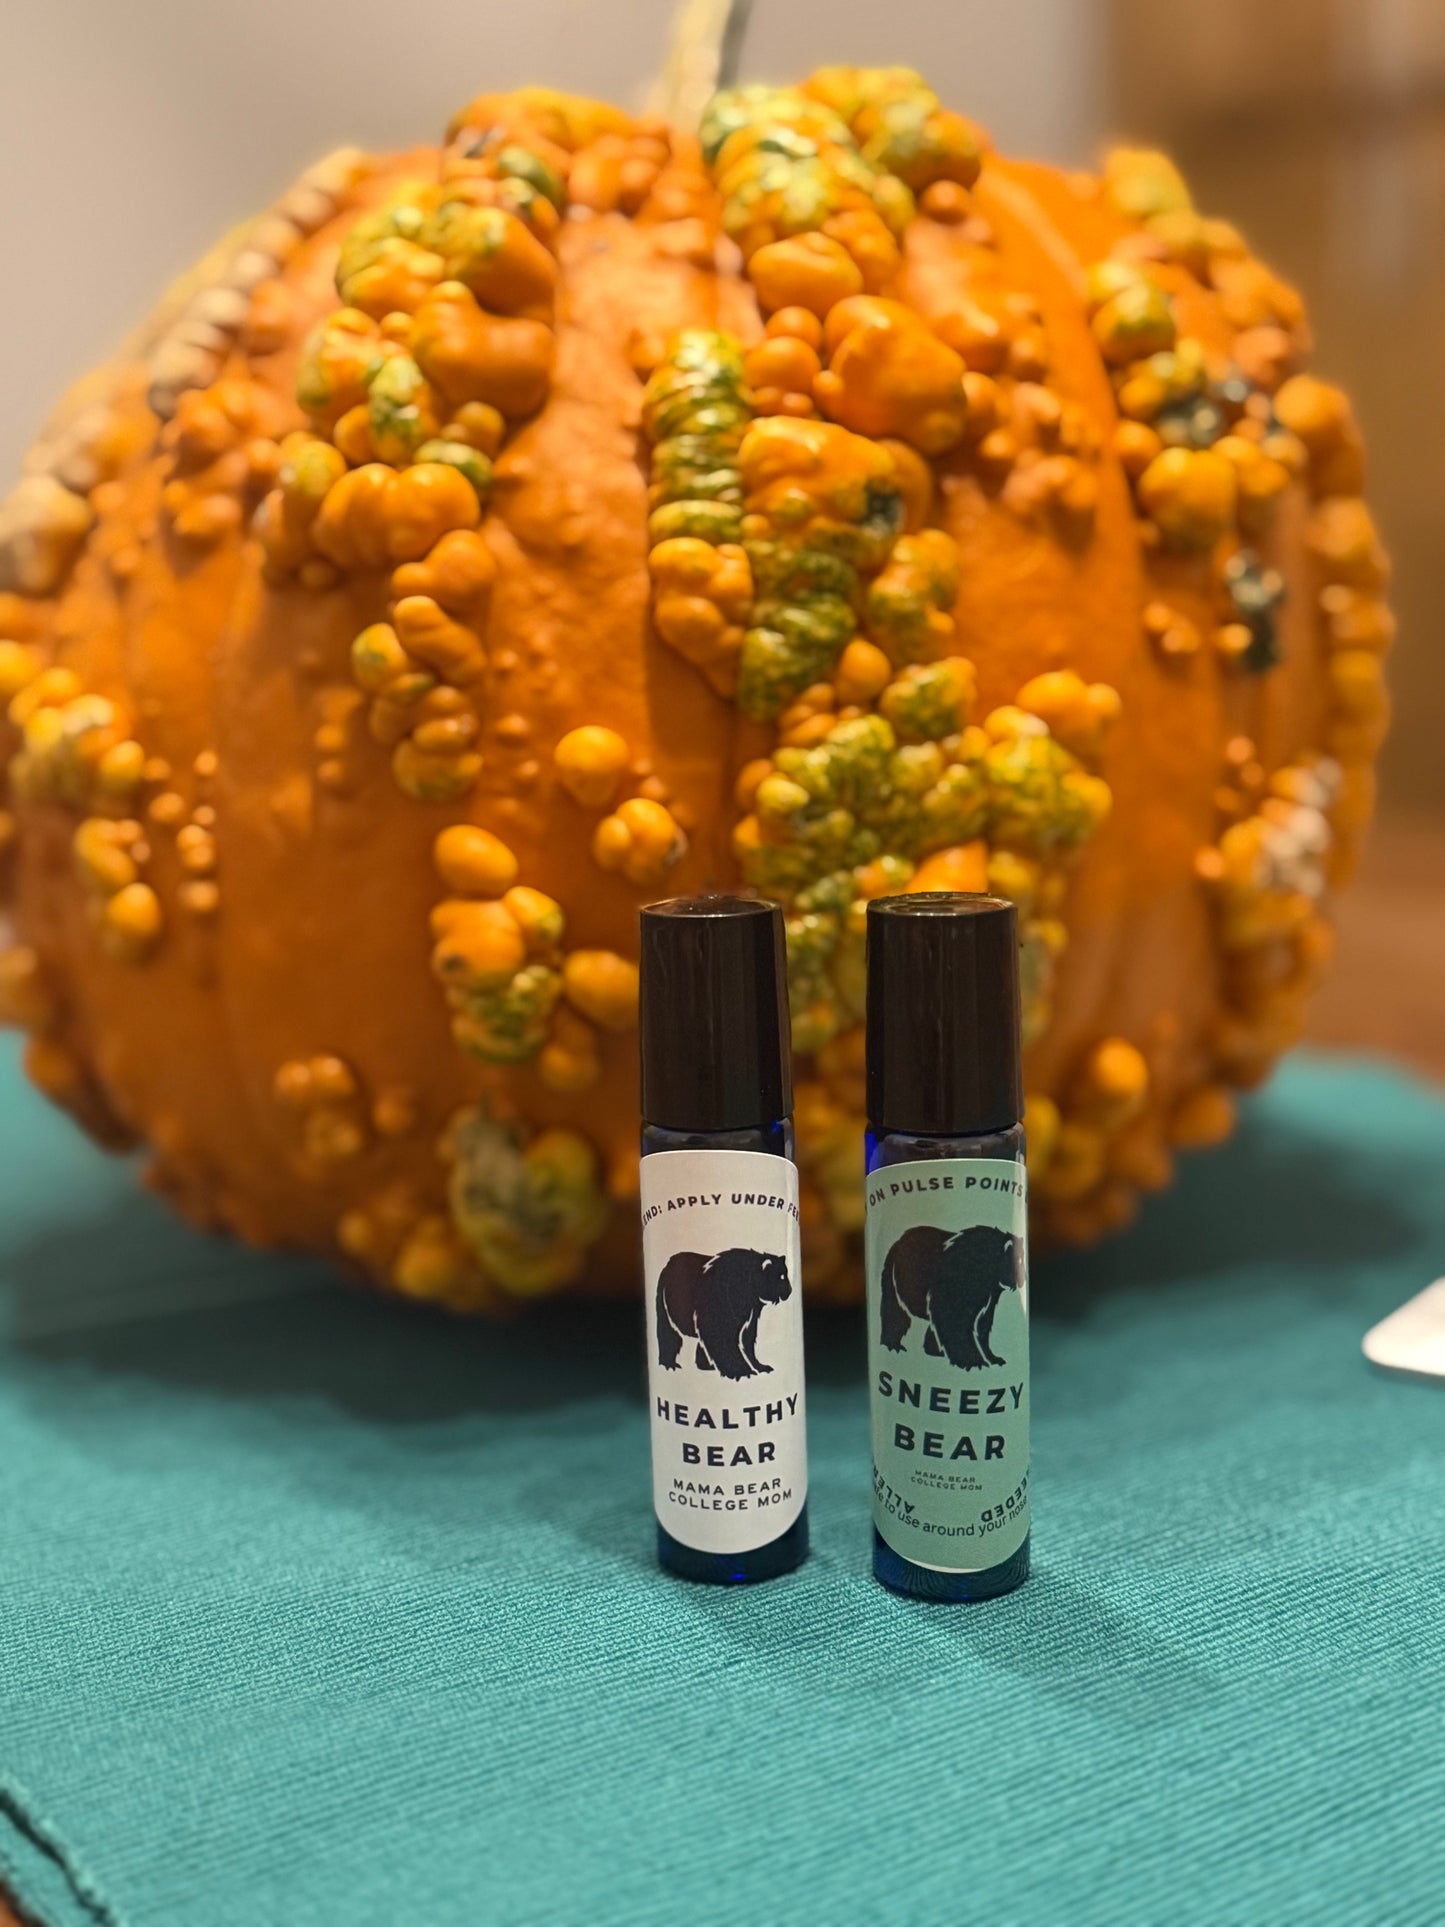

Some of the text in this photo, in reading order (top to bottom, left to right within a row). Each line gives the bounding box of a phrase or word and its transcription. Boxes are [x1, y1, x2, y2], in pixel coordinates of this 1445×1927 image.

[667, 1193, 721, 1211] APPLY
[731, 1193, 785, 1211] UNDER
[869, 1177, 1024, 1207] ON PULSE POINTS
[878, 1370, 1024, 1415] SNEEZY
[656, 1392, 798, 1430] HEALTHY
[682, 1441, 776, 1467] BEAR
[894, 1422, 1005, 1461] BEAR
[673, 1478, 781, 1496] MAMA BEAR
[910, 1476, 956, 1491] COLLEGE
[915, 1469, 976, 1483] MAMA BEAR
[668, 1488, 792, 1511] COLLEGE MOM
[884, 1499, 896, 1514] to
[897, 1511, 920, 1528] use
[922, 1523, 975, 1537] around
[978, 1514, 1007, 1538] your
